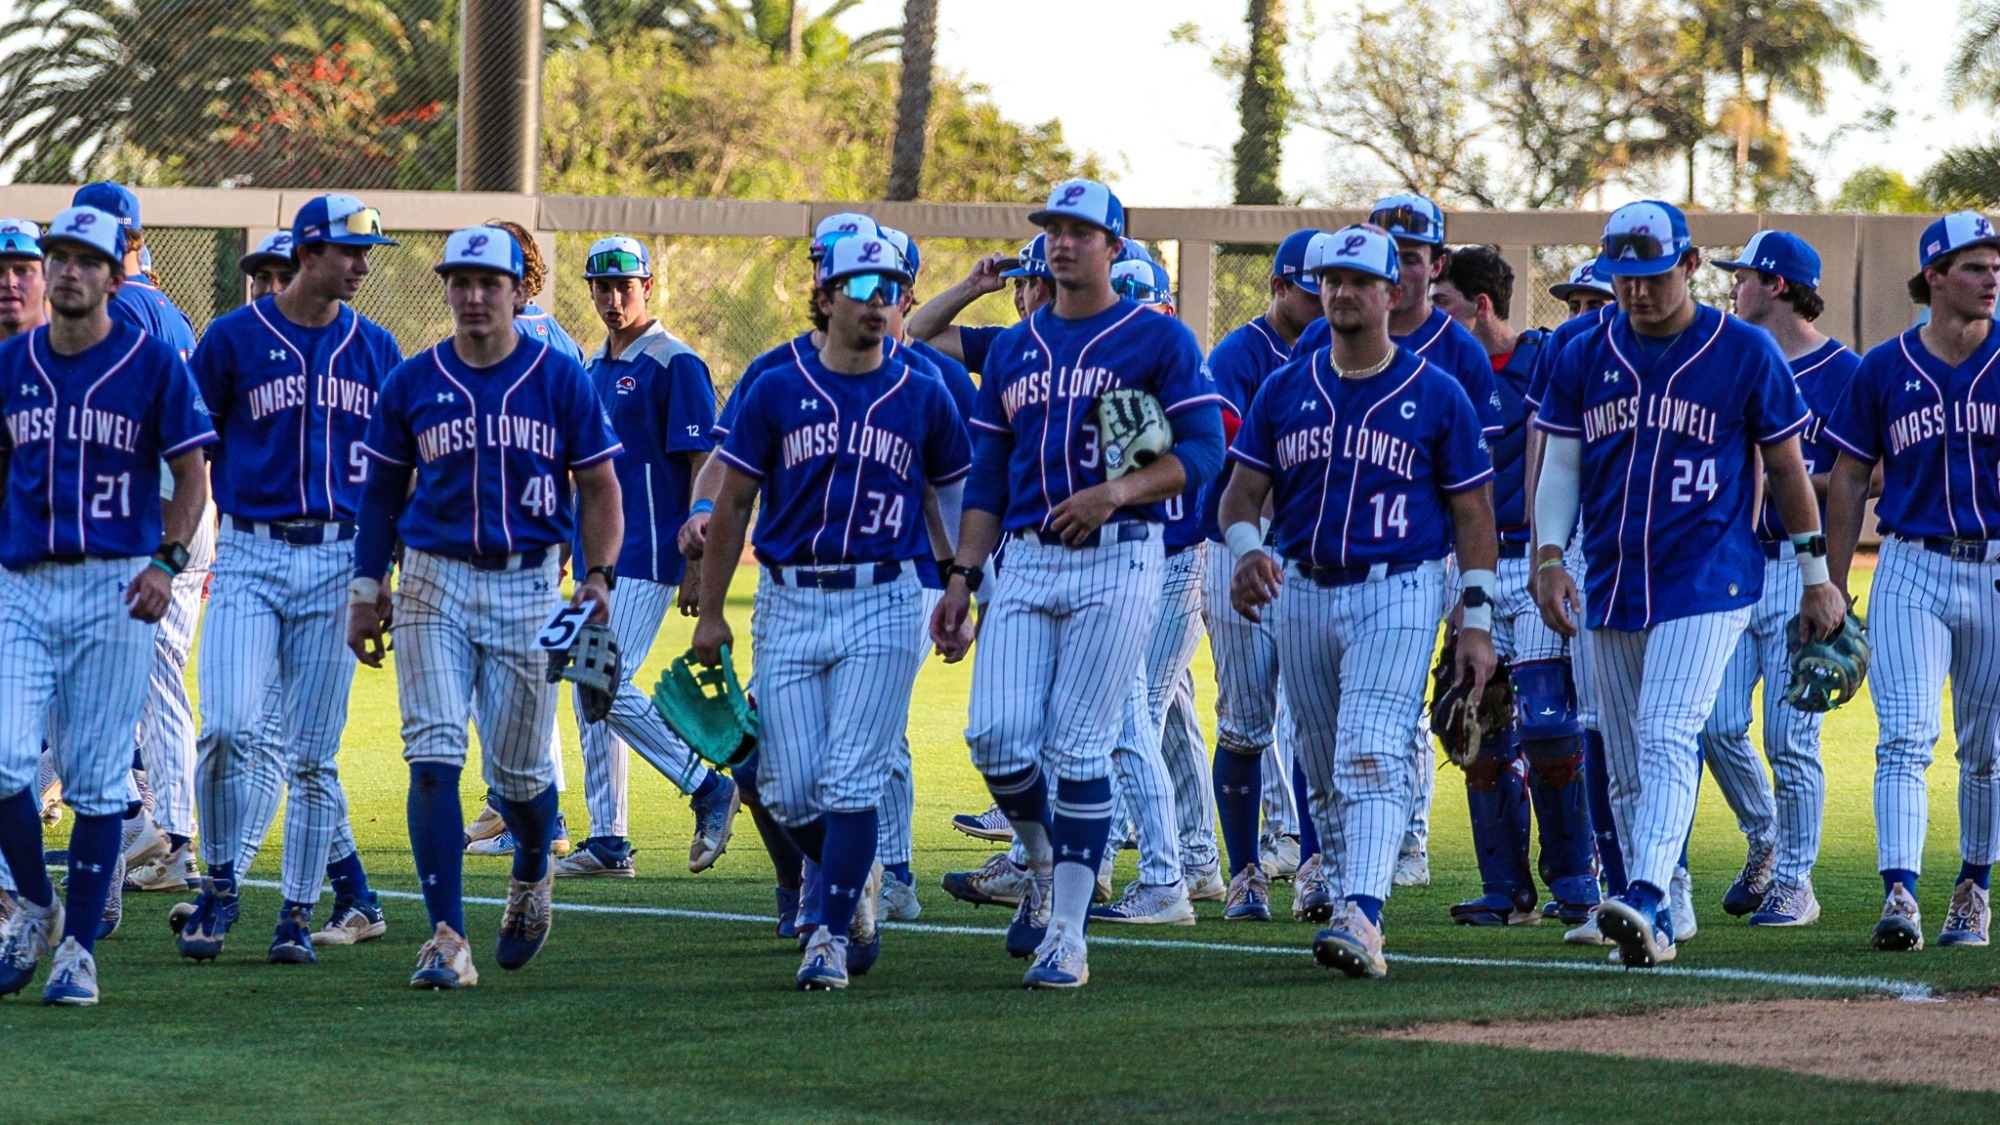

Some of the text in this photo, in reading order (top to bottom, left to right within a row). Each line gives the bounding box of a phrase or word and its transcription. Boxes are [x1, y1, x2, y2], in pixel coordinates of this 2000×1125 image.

[1055, 185, 1086, 207] L
[65, 212, 97, 234] L
[1335, 234, 1367, 257] L
[460, 234, 489, 258] L
[857, 241, 882, 264] L
[248, 374, 307, 421] UMASS
[1001, 370, 1052, 425] UMASS
[1400, 400, 1417, 420] C
[1583, 393, 1717, 445] UMASS LOWELL
[68, 405, 141, 453] LOWELL
[417, 413, 557, 464] UMASS LOWELL
[686, 425, 700, 437] 12
[783, 421, 913, 481] UMASS LOWELL
[1889, 401, 2000, 456] UMASS LOW
[1276, 424, 1416, 481] UMASS LOWELL
[91, 472, 131, 518] 21
[520, 474, 557, 517] 48
[1671, 459, 1719, 502] 24
[860, 491, 904, 538] 34
[1370, 493, 1408, 538] 14
[539, 607, 586, 648] 5
